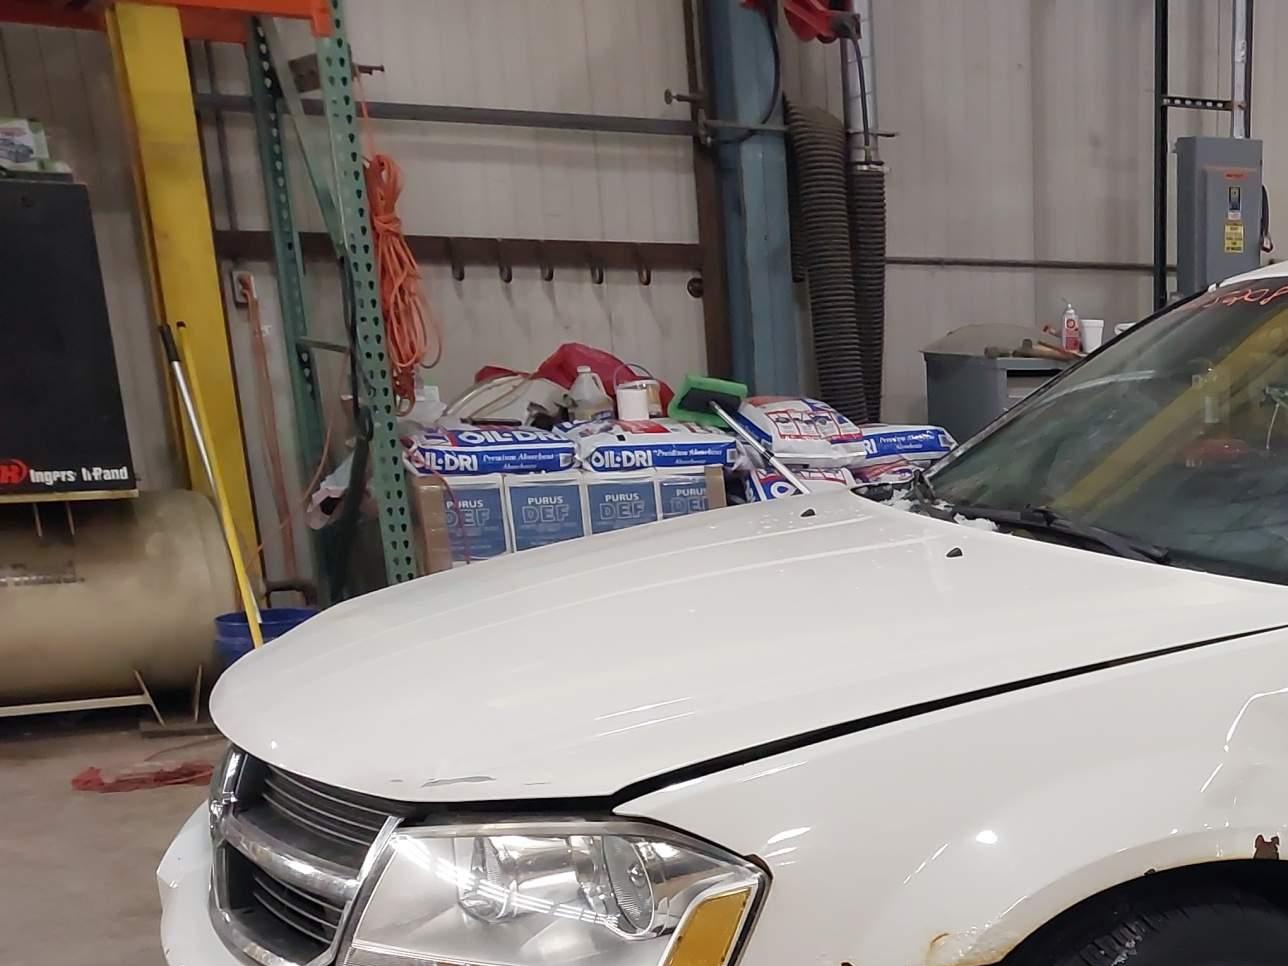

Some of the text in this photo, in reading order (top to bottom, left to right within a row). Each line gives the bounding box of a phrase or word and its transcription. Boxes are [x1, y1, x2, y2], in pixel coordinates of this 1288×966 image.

[527, 496, 563, 505] PURUS
[605, 492, 640, 502] PURUS
[522, 504, 570, 524] DEF
[600, 501, 645, 520] DEF
